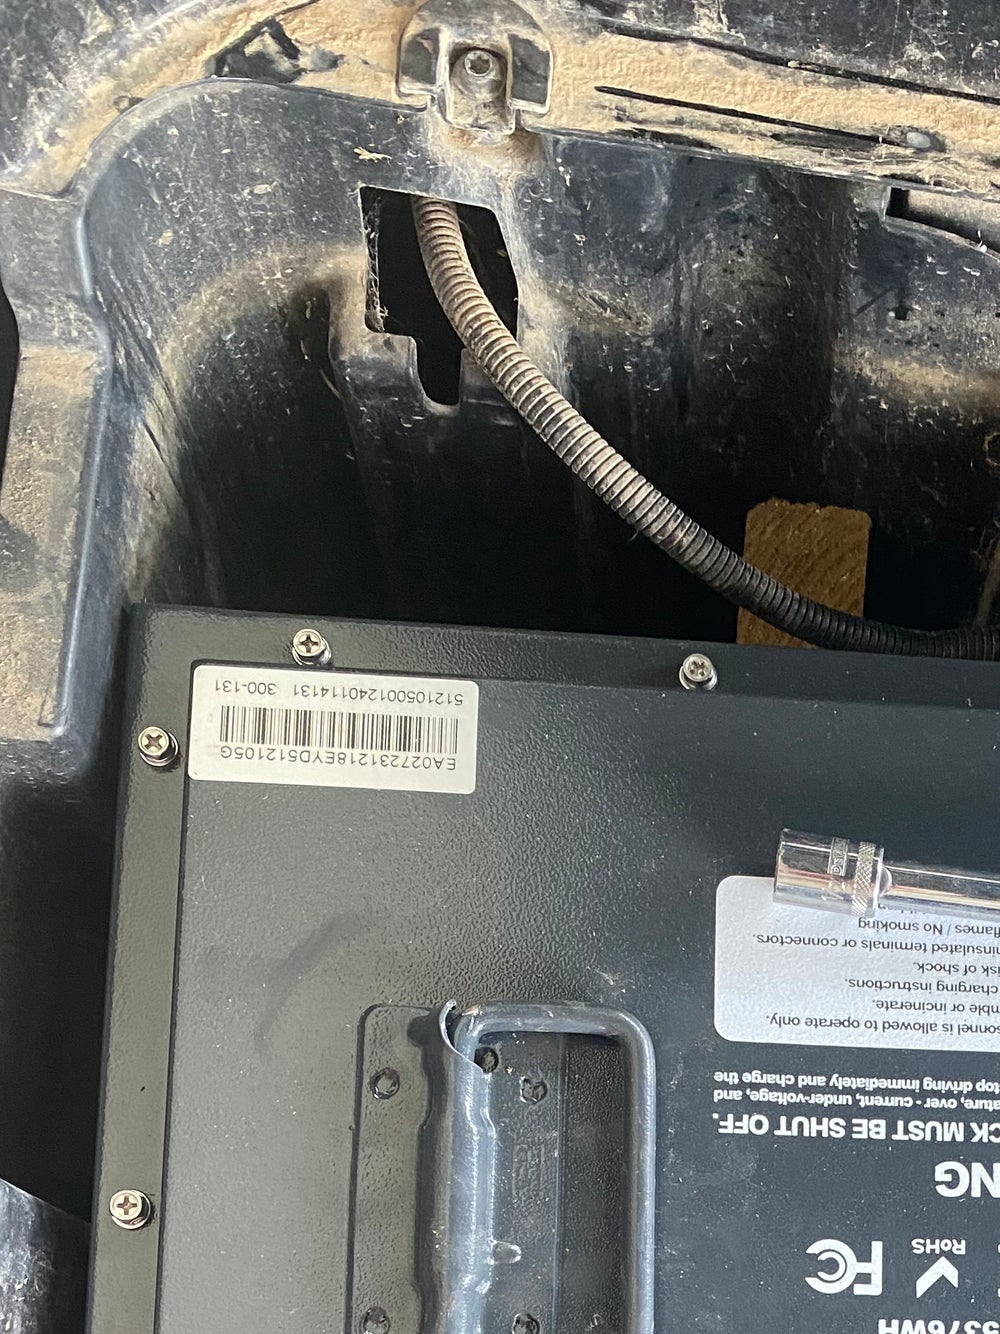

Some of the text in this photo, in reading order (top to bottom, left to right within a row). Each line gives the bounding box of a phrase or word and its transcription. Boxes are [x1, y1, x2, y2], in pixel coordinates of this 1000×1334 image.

[215, 680, 463, 705] 512105001240114131 300-131
[220, 746, 455, 770] EA027231218EYD512105G
[858, 918, 918, 932] smoking
[923, 923, 942, 934] No
[954, 924, 1000, 937] flames
[753, 934, 837, 946] connectors.
[842, 939, 856, 947] or
[861, 939, 926, 953] terminals
[913, 962, 958, 974] shock.
[963, 964, 976, 975] of
[845, 979, 931, 993] instructions.
[936, 980, 998, 995] charging
[872, 1000, 946, 1014] incinerate.
[950, 1003, 964, 1011] or
[766, 1013, 800, 1027] only.
[804, 1016, 859, 1028] operate
[864, 1020, 877, 1031] to
[882, 1021, 937, 1033] allowed
[942, 1023, 952, 1035] is
[713, 1071, 738, 1084] the
[742, 1070, 794, 1086] charge
[798, 1075, 826, 1087] and
[829, 1073, 919, 1092] immediately
[923, 1077, 972, 1093] driving
[713, 1089, 742, 1101] and
[746, 1088, 851, 1106] under-voltage,
[856, 1093, 913, 1107] current,
[923, 1098, 957, 1108] over
[712, 1113, 768, 1134] OFF.
[774, 1116, 845, 1137] SHUT
[852, 1118, 885, 1139] BE
[891, 1120, 963, 1141] MUST
[911, 1238, 965, 1254] RoHS
